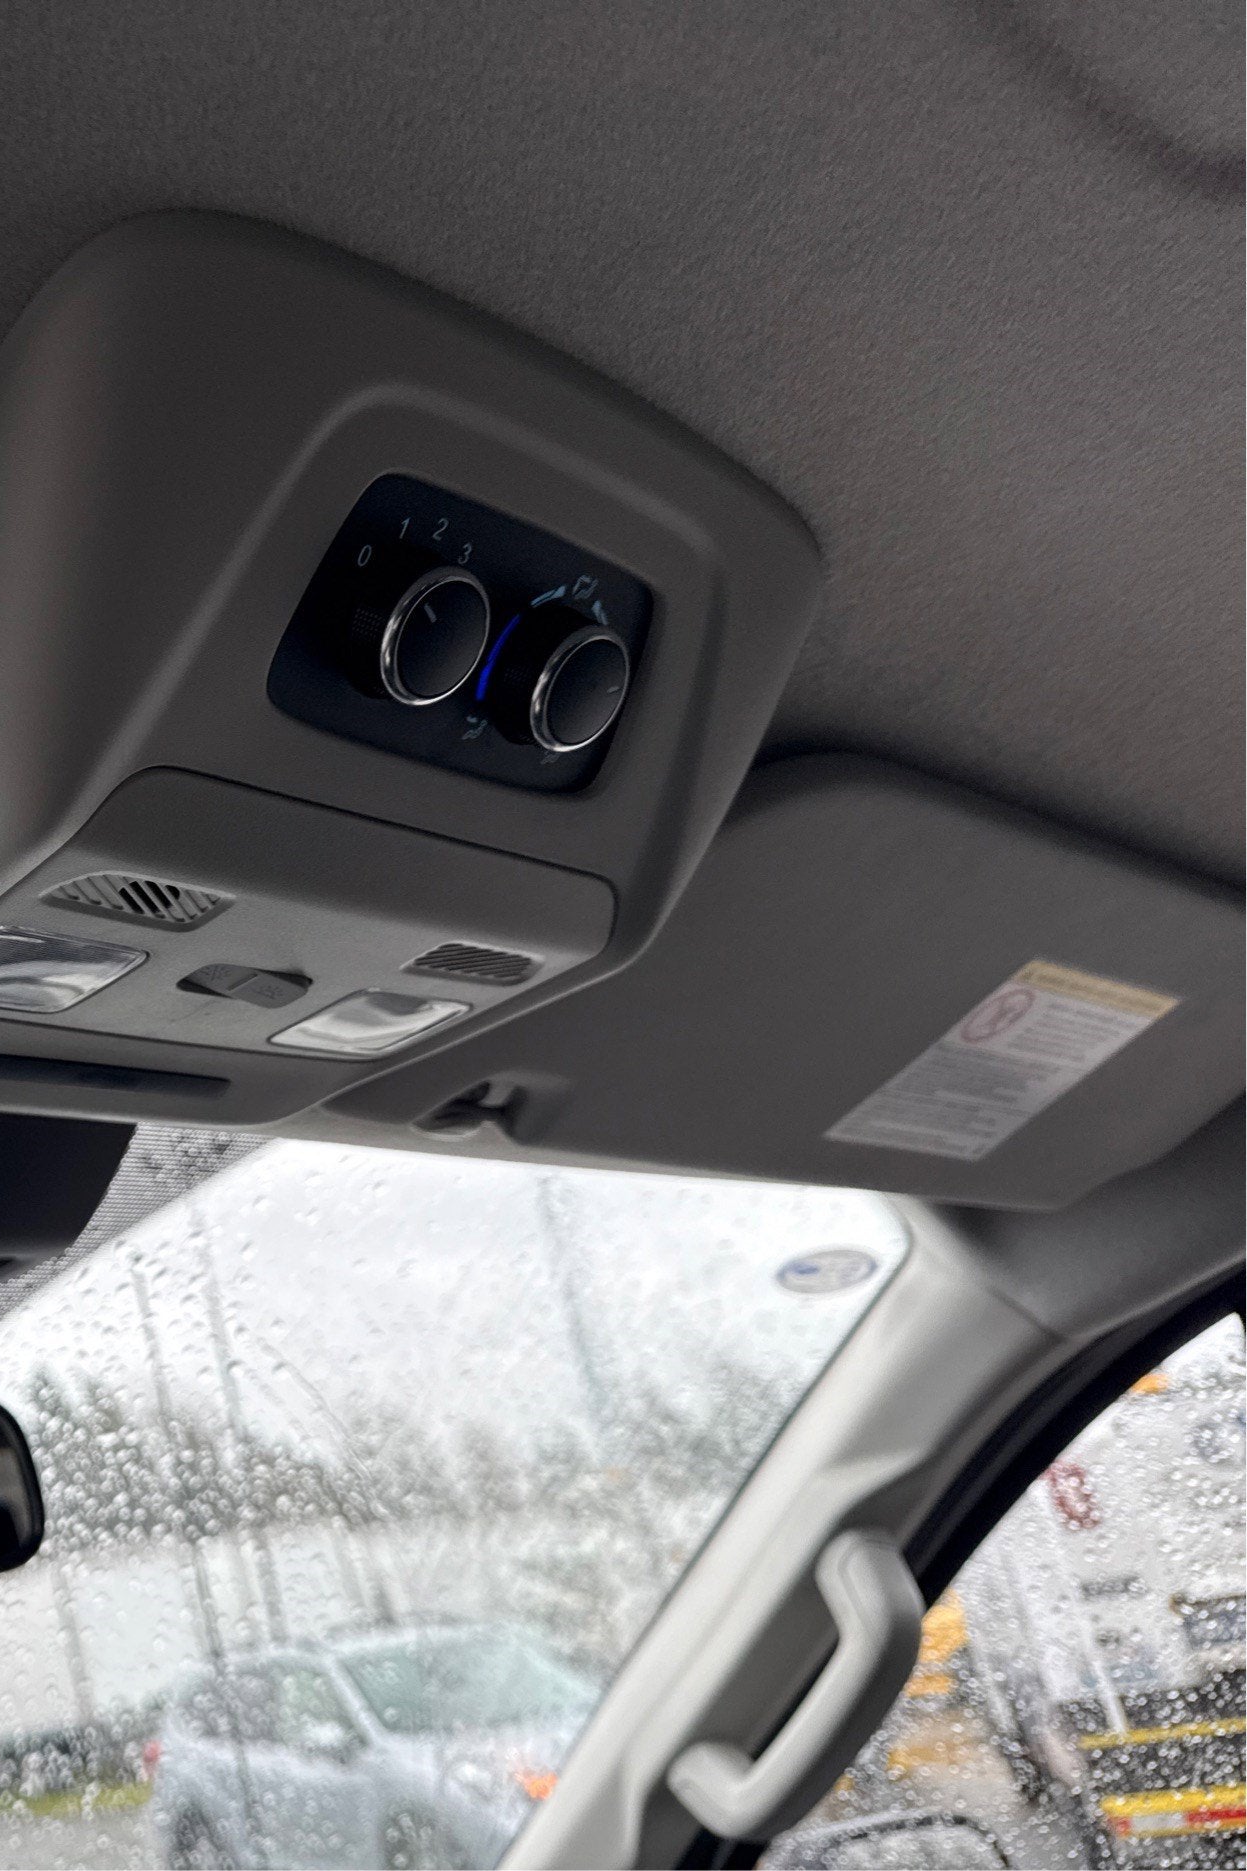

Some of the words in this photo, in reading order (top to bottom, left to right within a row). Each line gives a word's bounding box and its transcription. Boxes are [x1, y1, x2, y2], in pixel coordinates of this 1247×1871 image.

[357, 544, 372, 567] 0
[399, 517, 411, 539] 1
[432, 517, 449, 541] 2
[458, 542, 472, 565] 3
